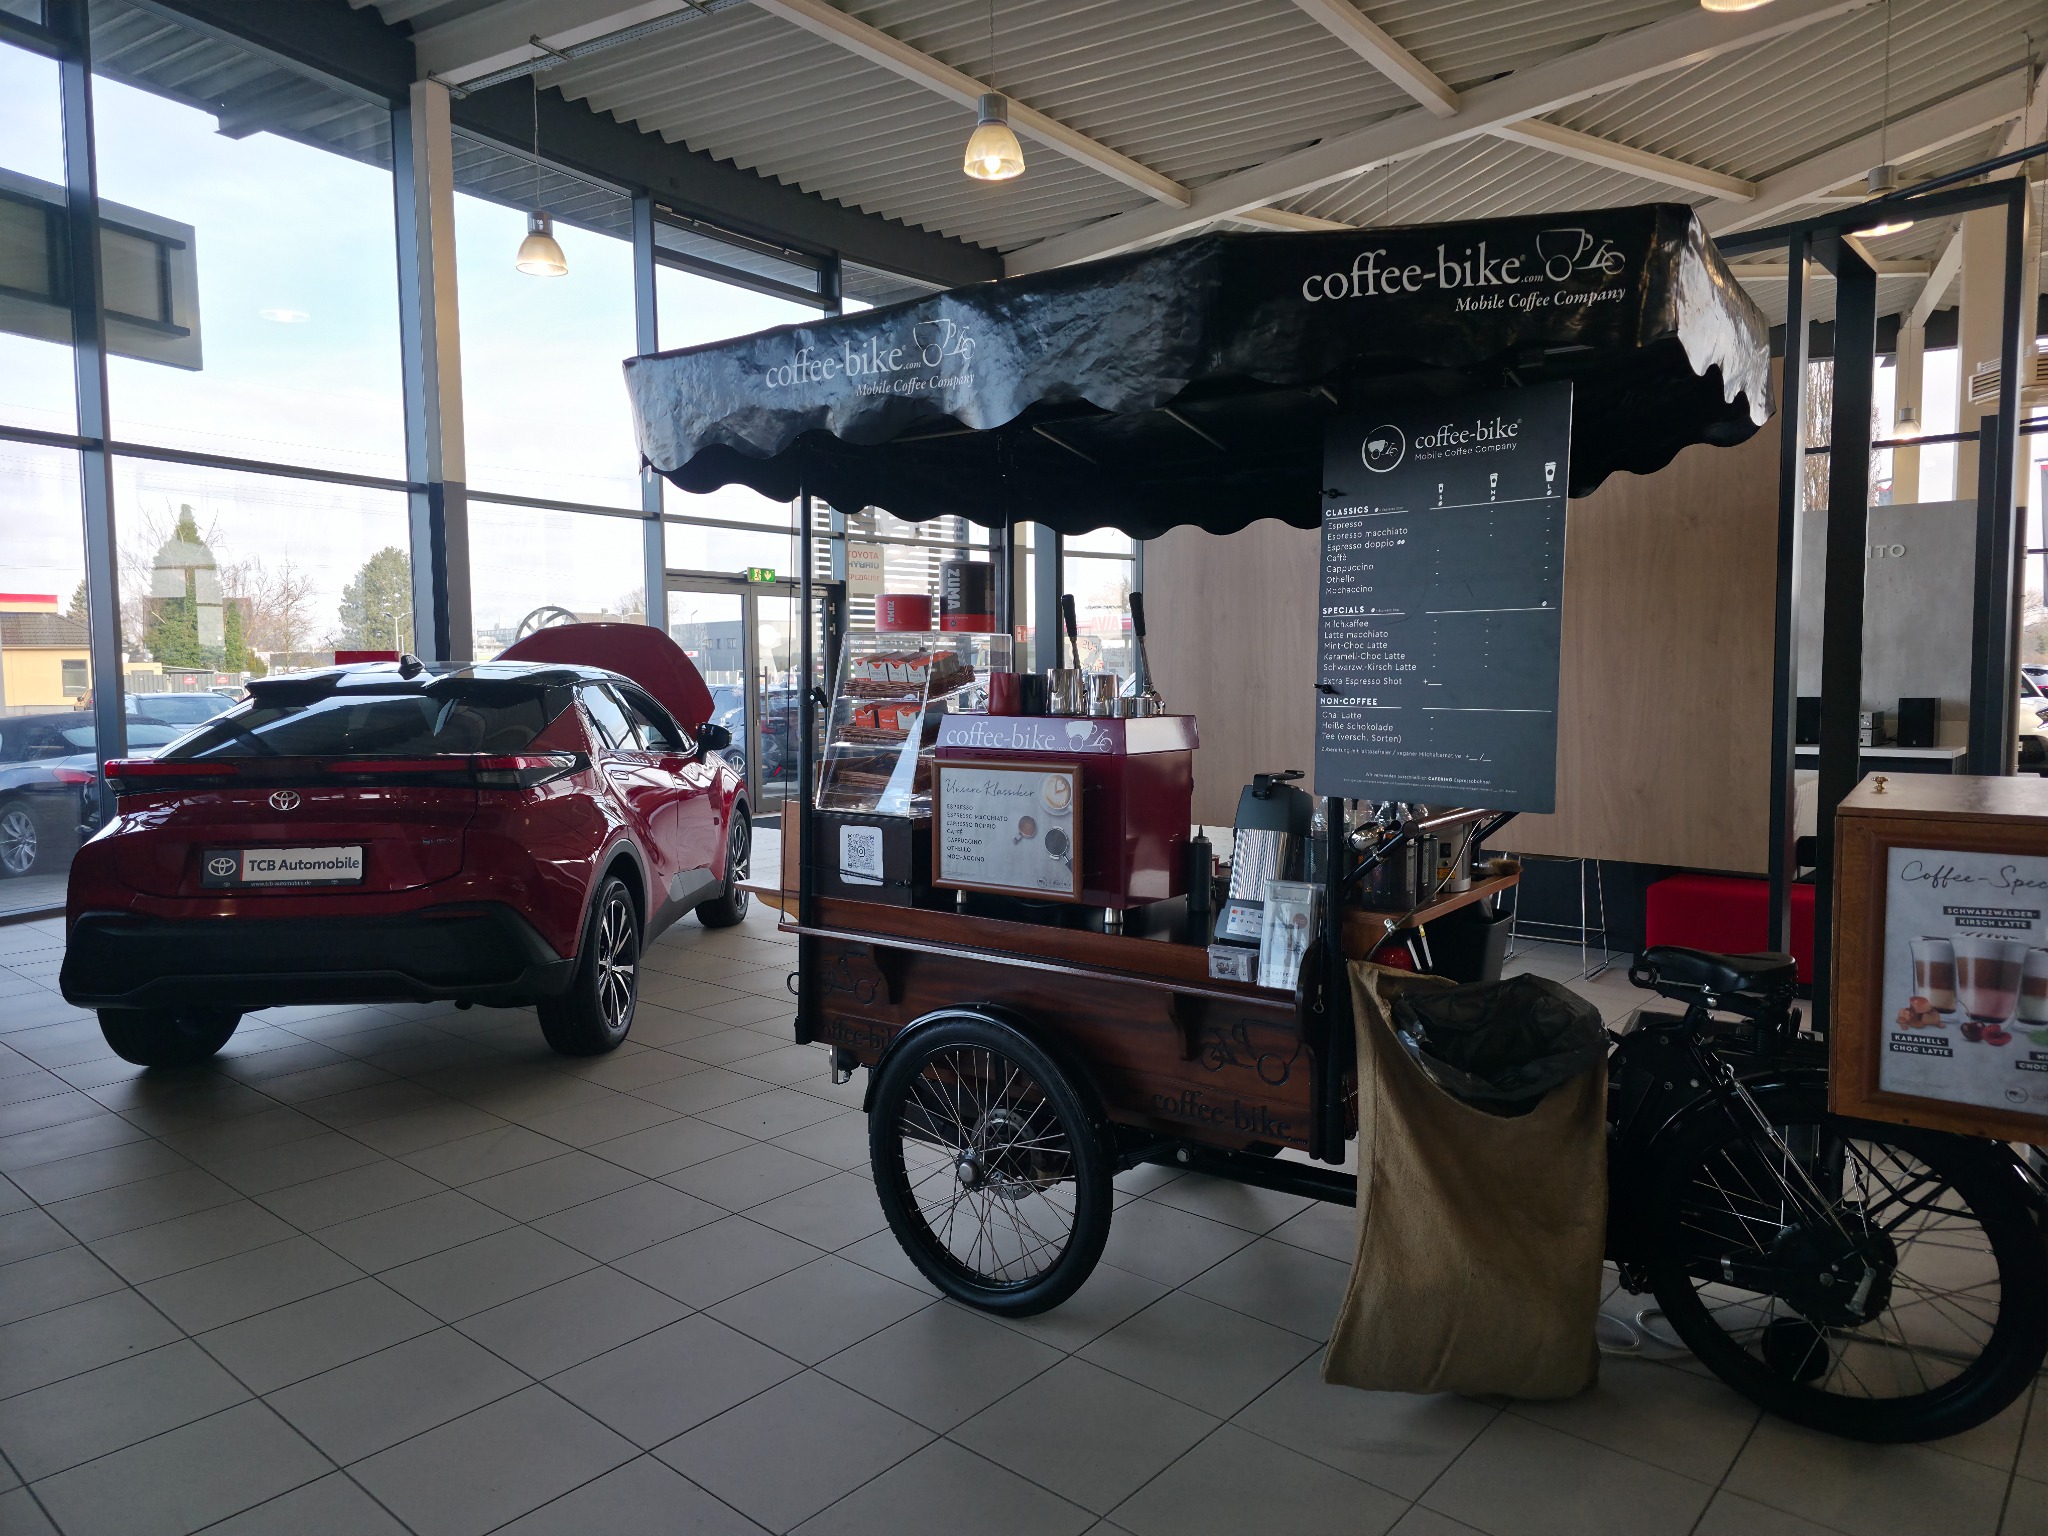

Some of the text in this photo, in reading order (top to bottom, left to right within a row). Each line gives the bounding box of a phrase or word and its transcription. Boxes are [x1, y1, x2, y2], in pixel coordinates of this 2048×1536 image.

[1455, 288, 1626, 312] Mobile Coffee Company
[856, 373, 975, 396] Mobile Coffee Company
[1414, 441, 1518, 461] Mobile Coffee Company
[1326, 506, 1369, 517] CLASSICS
[1328, 520, 1363, 530] Espresso
[1327, 527, 1408, 541] Espresso macchiato
[1327, 539, 1395, 552] Espresso doppio
[848, 550, 879, 560] TOYOTA
[1326, 563, 1374, 573] Cappuccino
[1326, 575, 1355, 584] Othello
[947, 568, 961, 610] ZUMA
[1326, 584, 1373, 595] Mochaccino
[887, 600, 895, 624] ZUMA
[1322, 605, 1365, 615] SPECIALS
[1324, 619, 1369, 628] Milchkaffee
[1324, 630, 1389, 639] Latte macchiato
[1324, 641, 1388, 650] Mint-Choc Latte
[1323, 652, 1406, 661] Karamell-Choc Latte
[1323, 663, 1417, 671] Schwarzw.-Kirsch Latte
[1323, 677, 1403, 686] Extra Espresso Shot
[1320, 697, 1378, 706] NON-COFFEE
[1322, 711, 1362, 720] Chai Latte
[1322, 721, 1394, 732] Heiße Schokolade
[946, 721, 1056, 750] coffee-bike
[1322, 732, 1402, 744] Tee (versch. Sorten)
[945, 778, 1034, 797] Unsere Klassiker
[946, 803, 974, 811] ESPRESSO
[974, 814, 1008, 822] MACCHIATO
[946, 820, 996, 830] ESPRESSO DOPPIO
[946, 837, 983, 846] CAPPUCCINO
[249, 857, 359, 871] TCB Automobile
[1947, 907, 2036, 918] SCHWARZWÄLDER-
[1959, 918, 2028, 929] KIRSCH LATTE
[1894, 1035, 1946, 1045] KARAMELL-
[1893, 1044, 1950, 1056] CHOC LATTE
